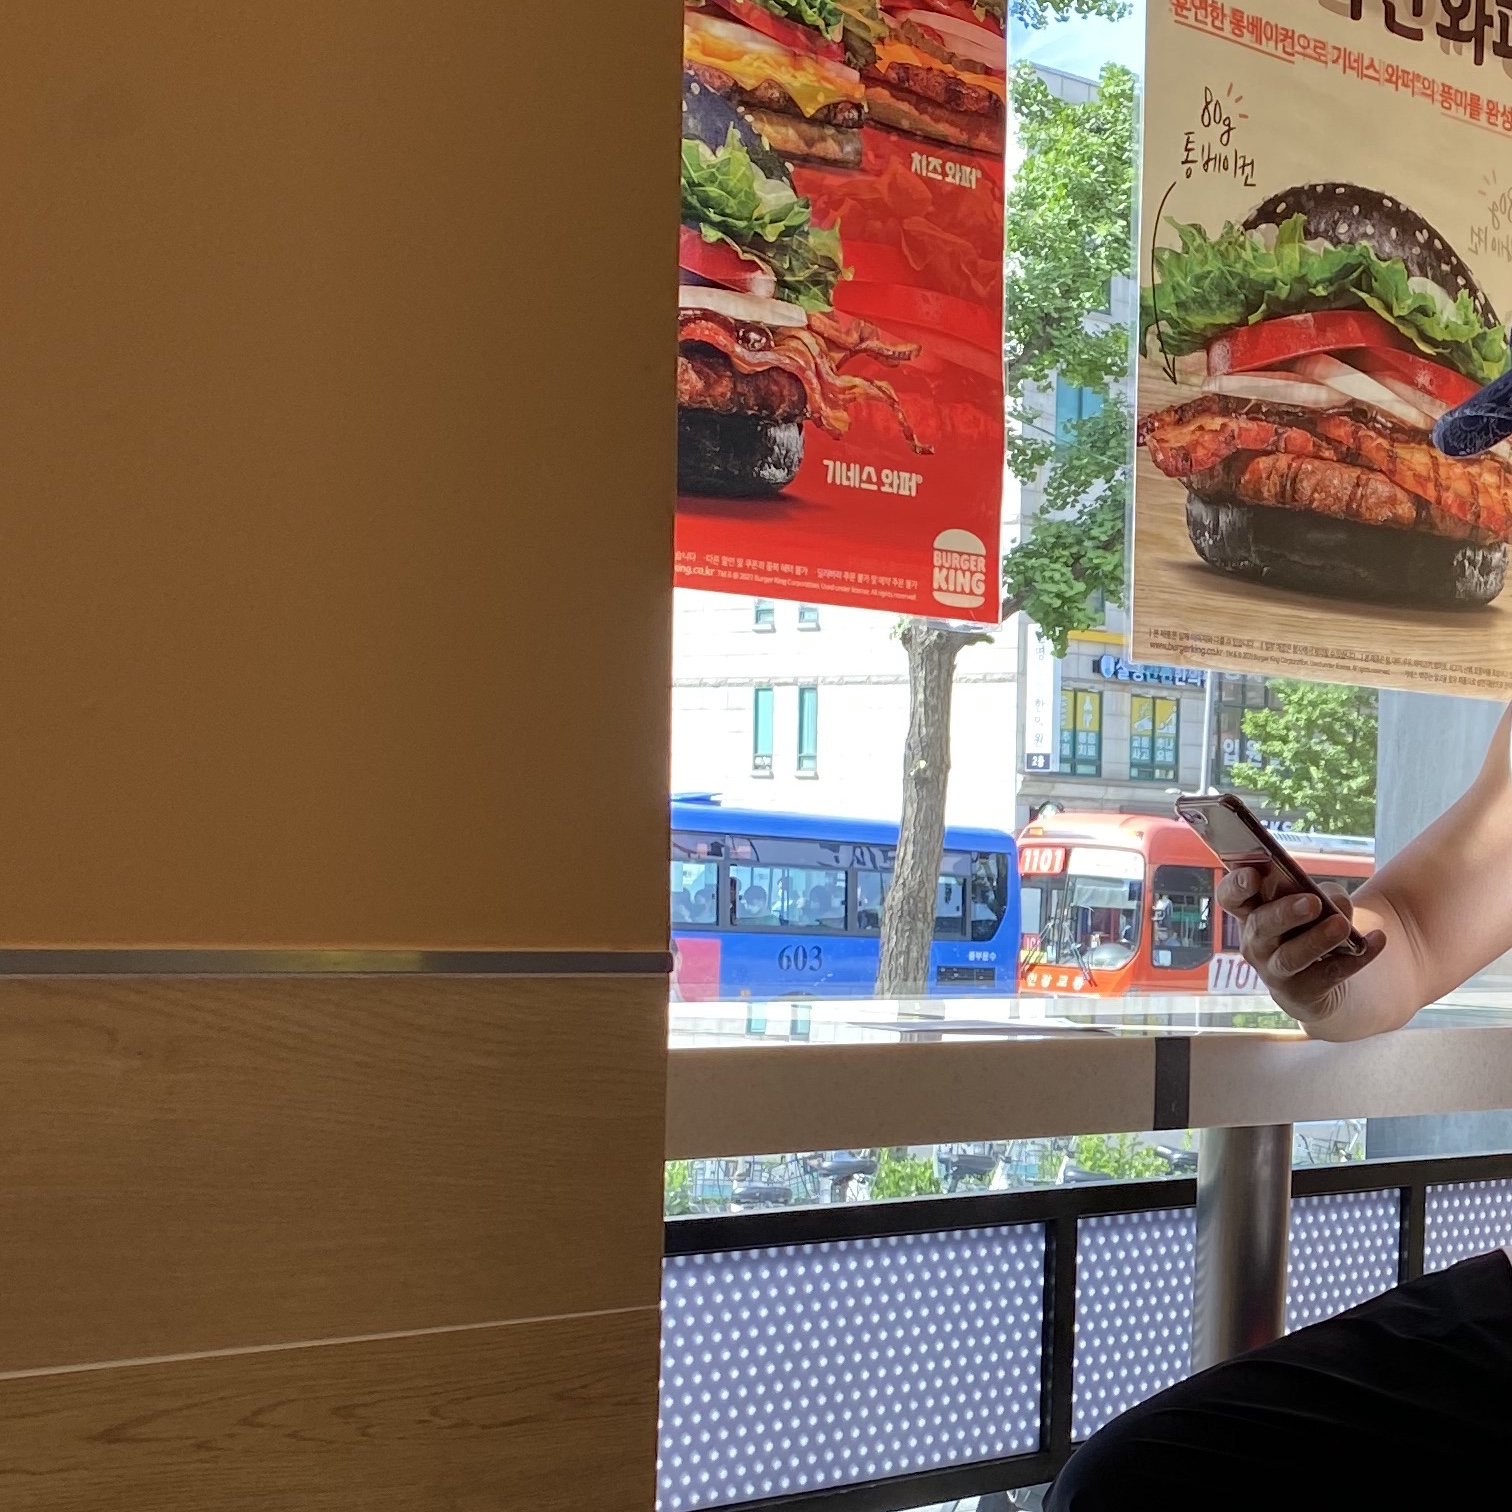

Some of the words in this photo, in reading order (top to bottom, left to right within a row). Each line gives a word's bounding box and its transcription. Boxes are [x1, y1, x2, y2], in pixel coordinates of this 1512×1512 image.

[1229, 8, 1328, 66] 통베이컨으로
[1331, 45, 1380, 83] 기네스
[1439, 82, 1483, 121] 풍미를
[1201, 86, 1236, 146] 80g
[1181, 131, 1256, 187] 통베이컨
[822, 459, 878, 490] 기네스
[933, 550, 986, 573] BURGER
[932, 567, 986, 595] KING
[1023, 847, 1065, 873] 1101
[777, 944, 823, 972] 603
